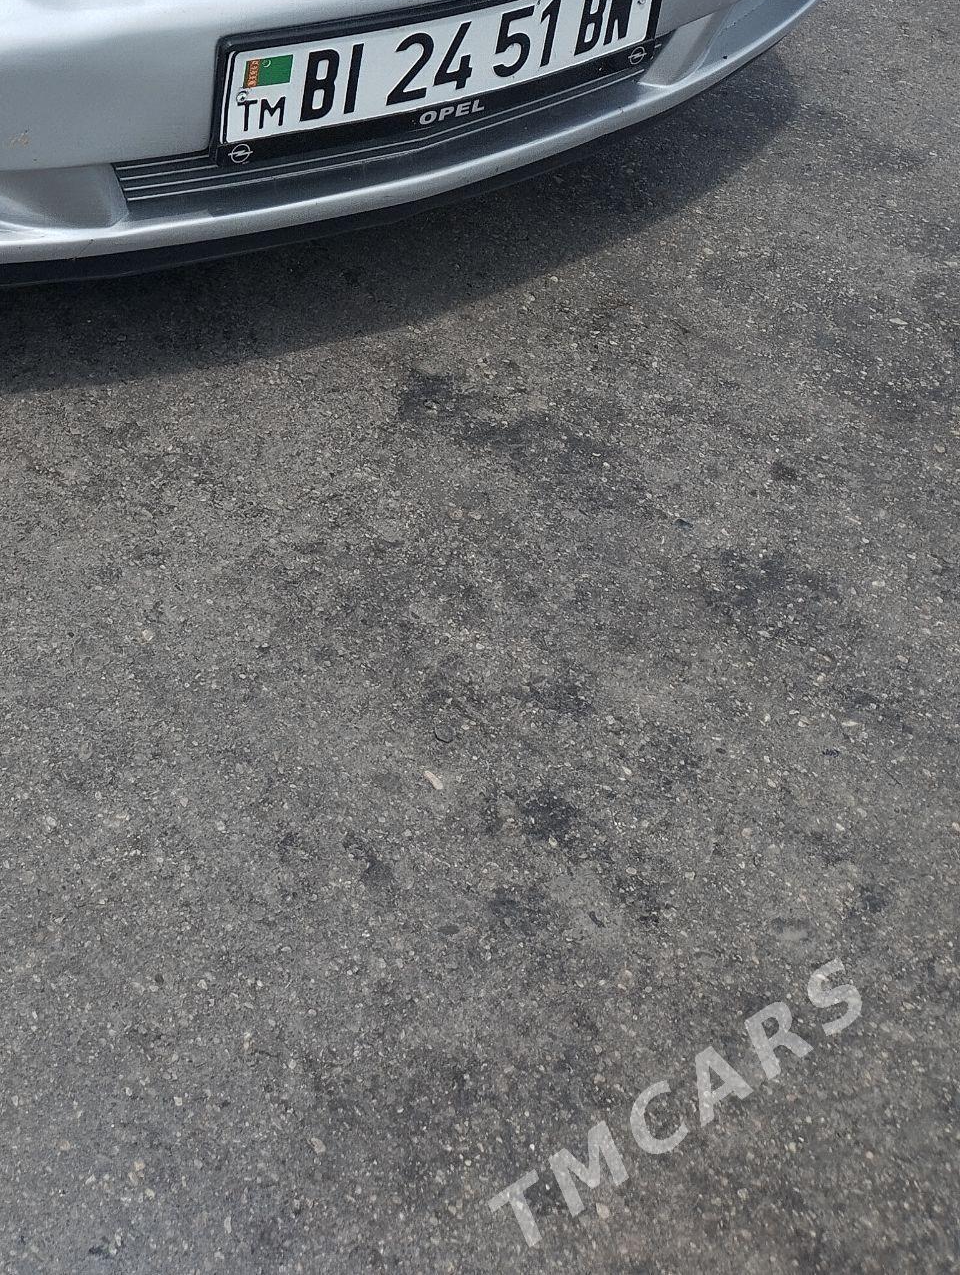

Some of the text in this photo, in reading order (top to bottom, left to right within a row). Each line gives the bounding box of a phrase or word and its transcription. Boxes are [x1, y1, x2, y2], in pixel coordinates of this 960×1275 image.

[237, 96, 286, 132] TM
[300, 43, 365, 122] BI
[385, 20, 473, 106] 24
[419, 98, 486, 125] OPEL
